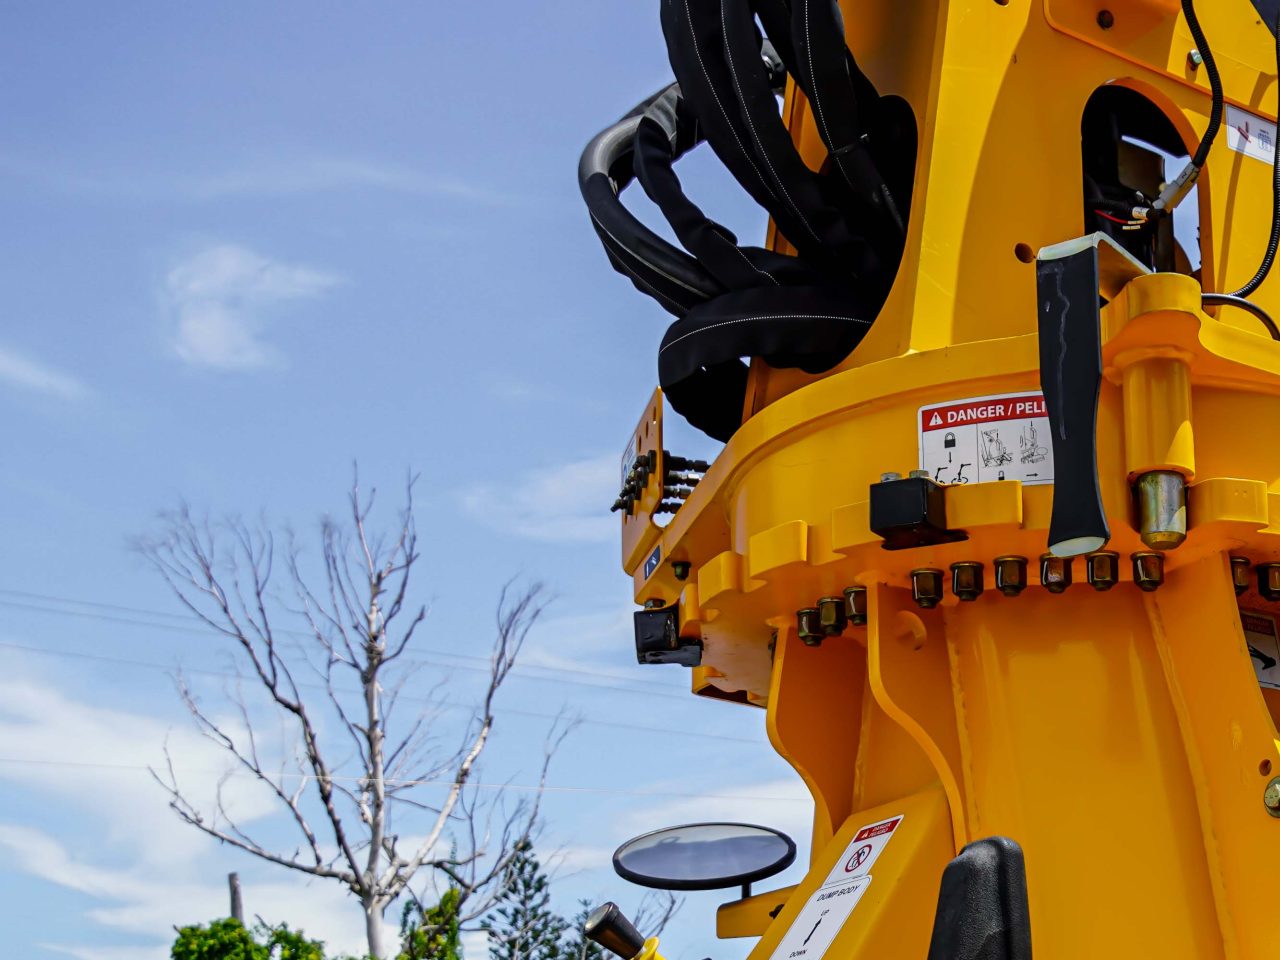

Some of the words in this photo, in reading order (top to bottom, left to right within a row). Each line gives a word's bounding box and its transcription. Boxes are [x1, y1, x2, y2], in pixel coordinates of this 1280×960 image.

[947, 405, 1004, 423] DANGER
[1016, 401, 1046, 415] PELI
[817, 889, 840, 901] DUMP
[837, 884, 862, 897] BODY
